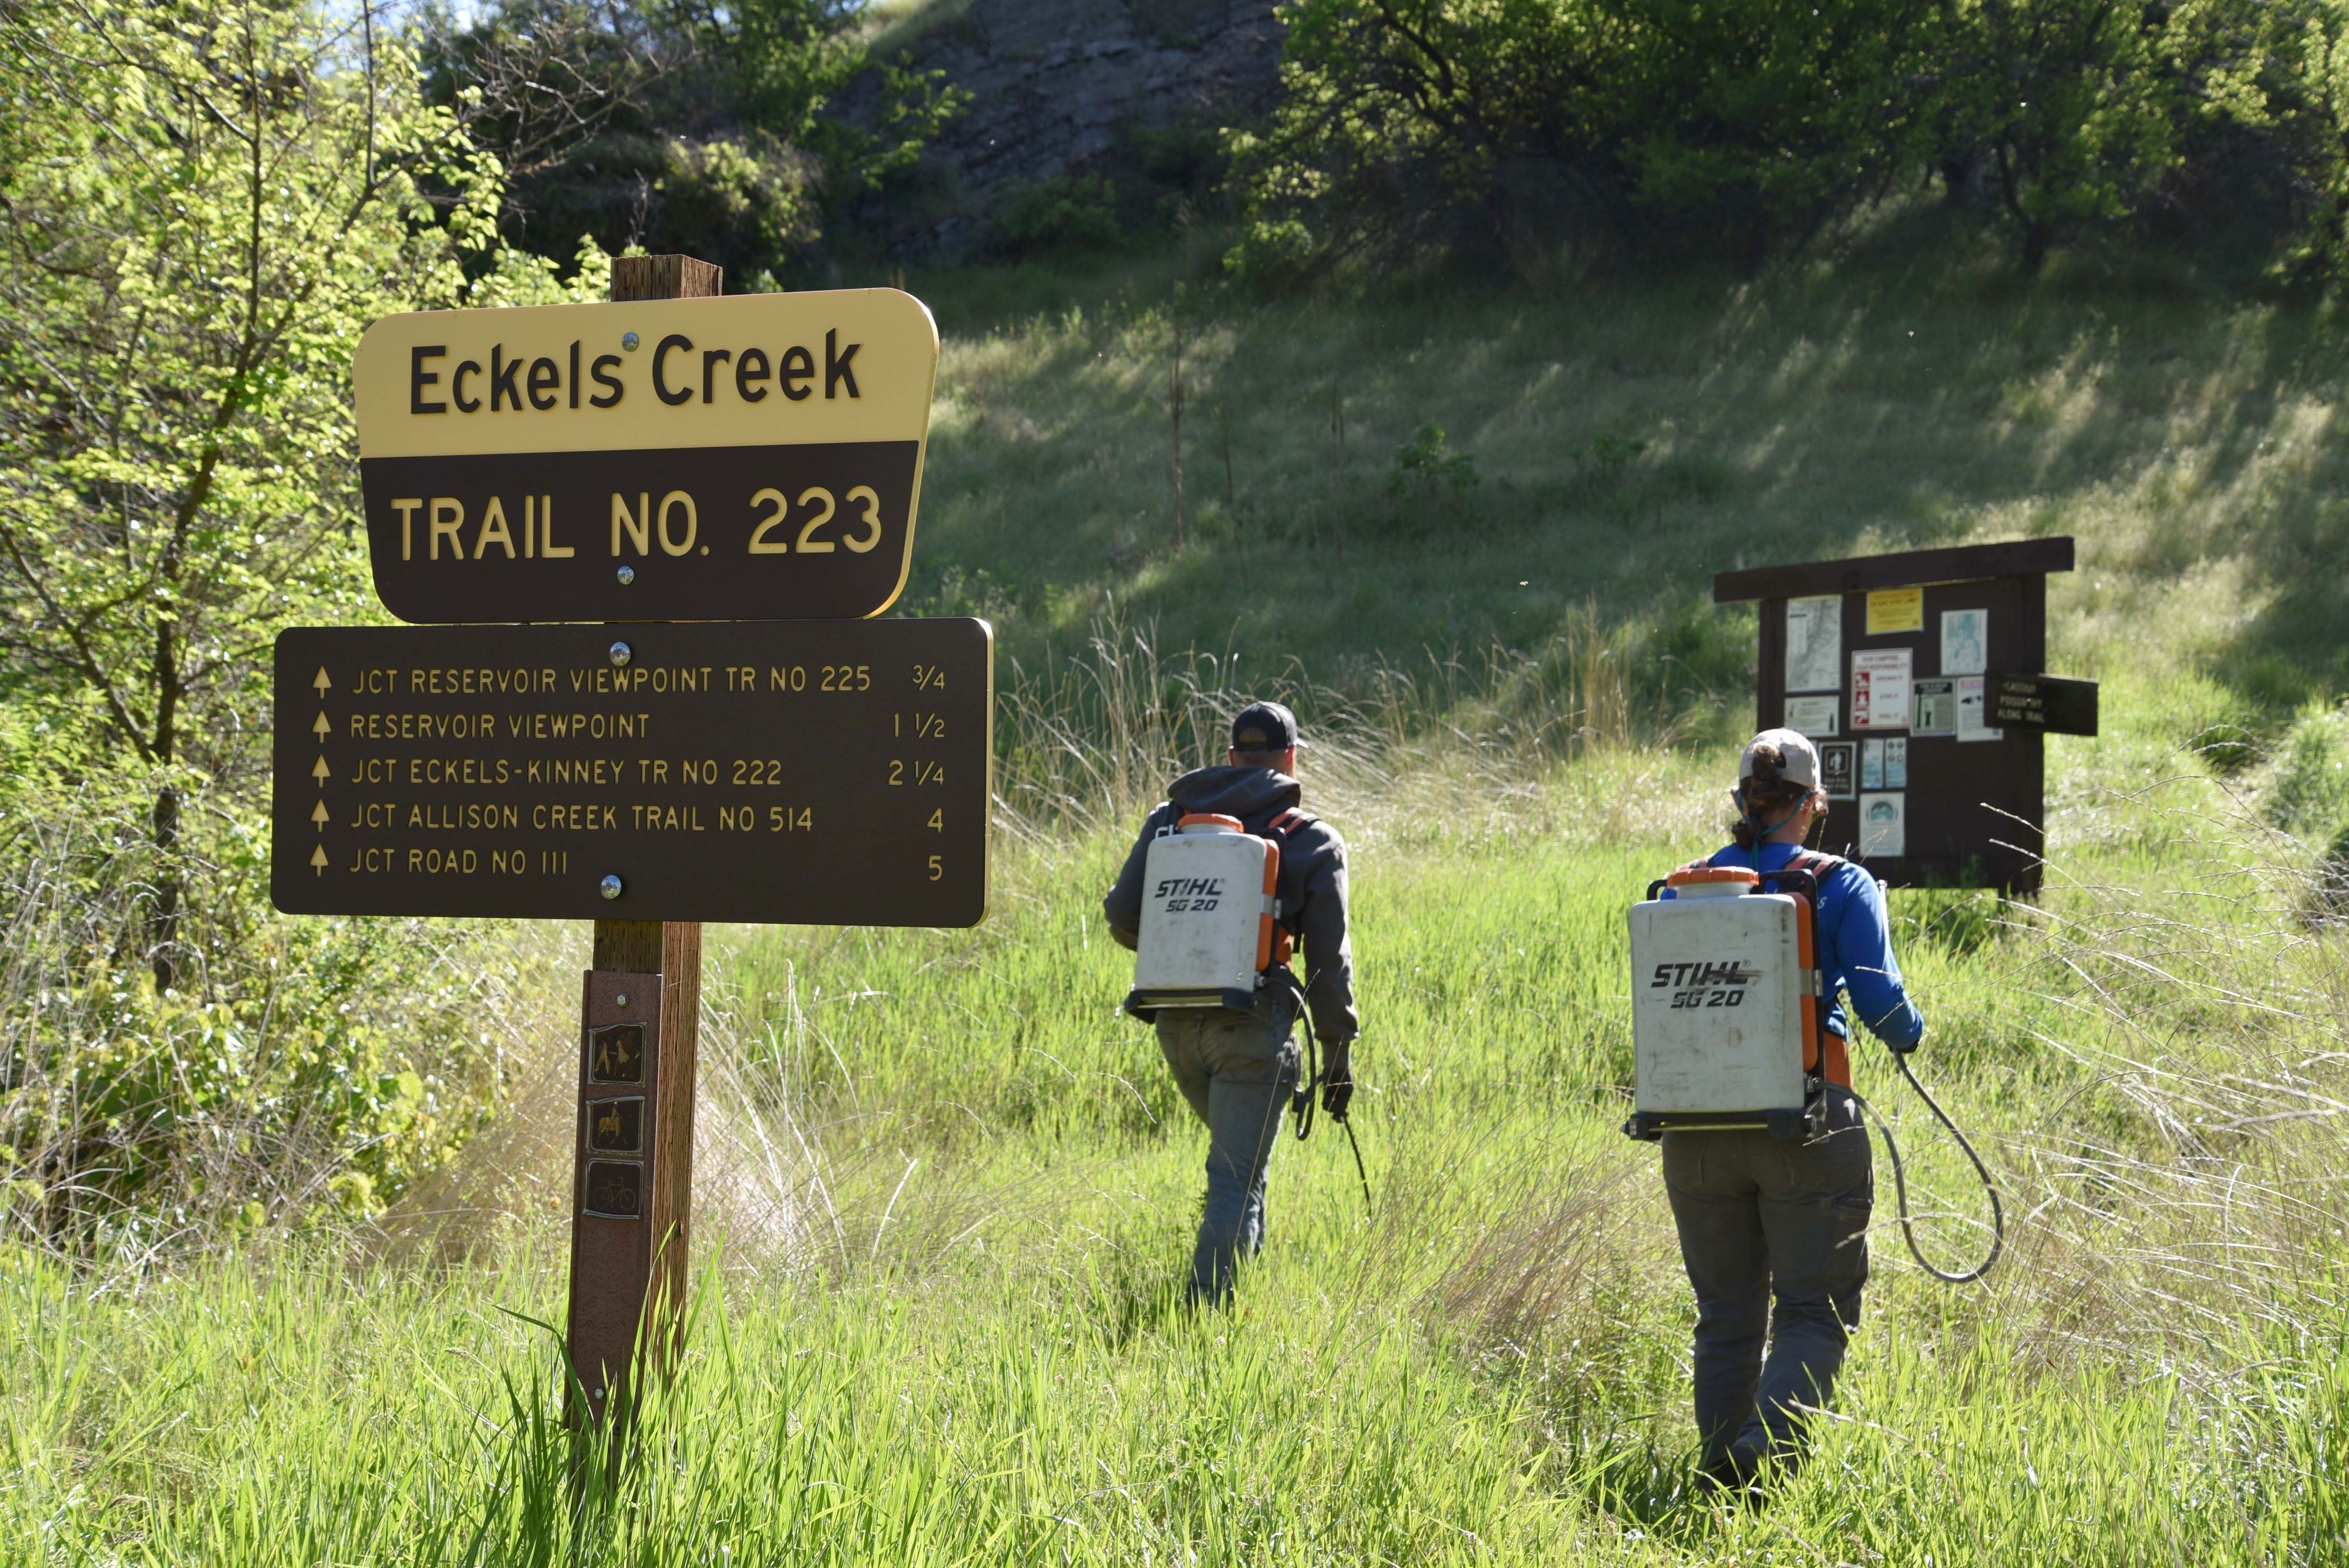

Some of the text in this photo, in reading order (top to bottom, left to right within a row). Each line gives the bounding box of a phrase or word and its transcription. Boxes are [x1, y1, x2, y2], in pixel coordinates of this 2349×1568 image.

[410, 328, 861, 415] Eckels Creek
[392, 486, 882, 561] TRAIL NO. 223
[352, 669, 398, 694] JCT
[411, 668, 556, 694] RESERVOIR
[570, 667, 712, 693] VIEWPOINT
[725, 667, 756, 692] TR
[770, 666, 806, 692] NO
[820, 665, 870, 691] 225
[351, 714, 495, 739] RESERVOIR
[509, 714, 649, 739] VIEWPOINT
[893, 712, 900, 738] 1
[351, 758, 397, 783] JCT
[410, 759, 624, 784] ECKELS-KINNEY
[638, 759, 668, 783] TR
[683, 759, 718, 785] NO
[732, 759, 782, 785] 222
[889, 759, 903, 786] 2
[351, 803, 943, 832] JCT ALLISON CREEK TRAIL NO 514 4
[350, 848, 943, 881] JCT ROAD NO 111 5
[1154, 878, 1222, 899] STIHL
[1165, 899, 1218, 913] SG 20
[1651, 961, 1748, 988] STIHL
[1670, 990, 1745, 1008] SG 20
